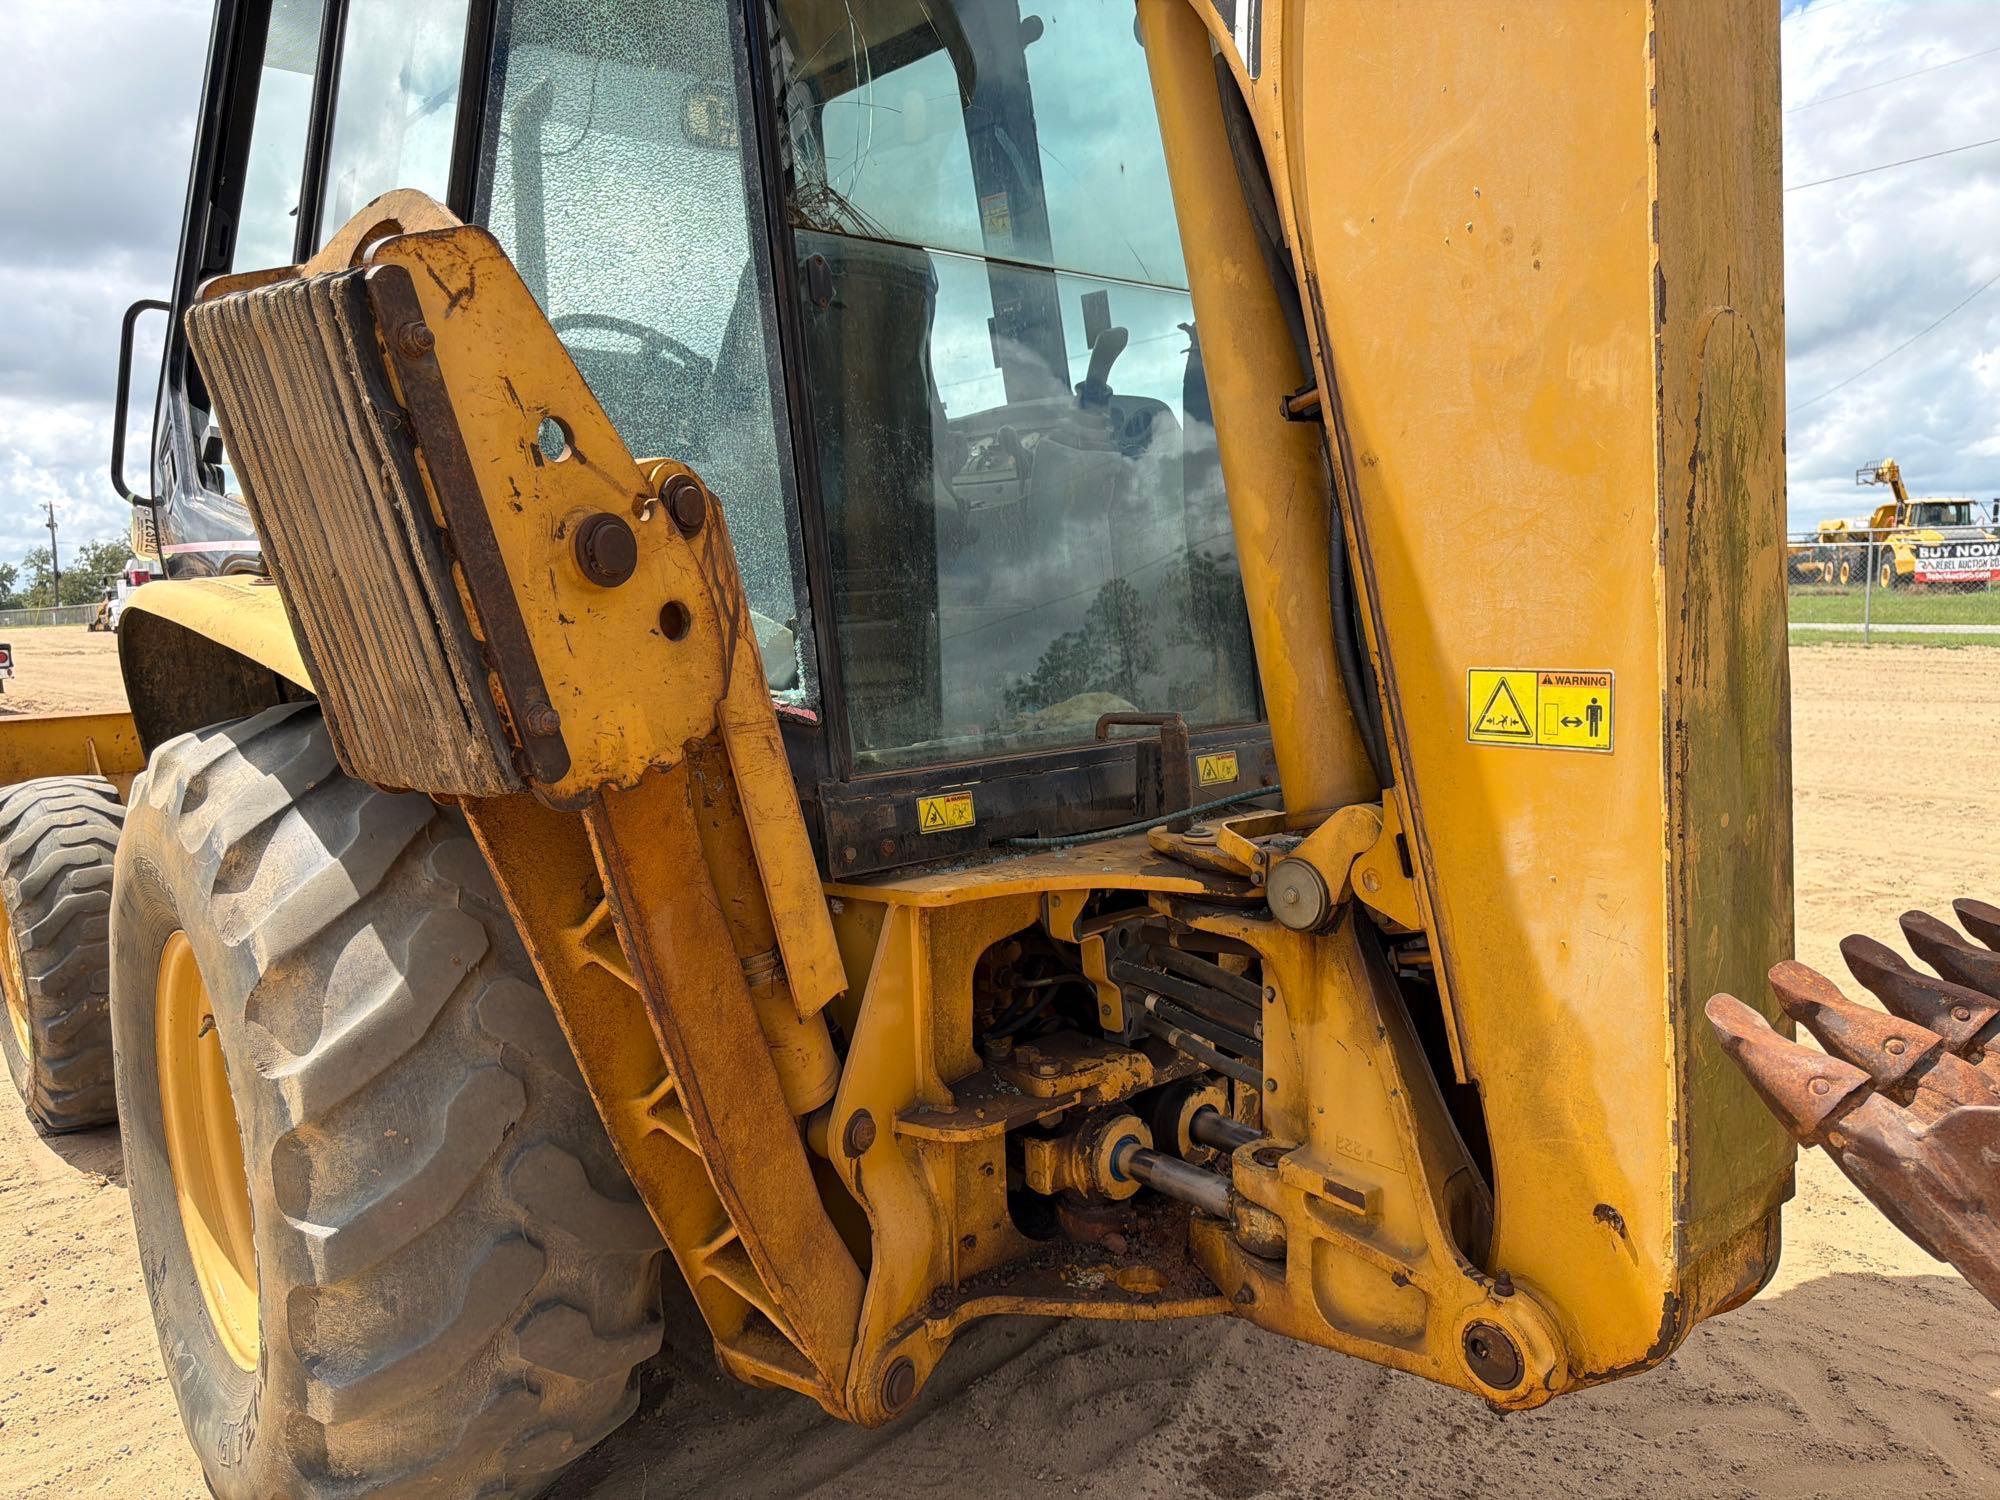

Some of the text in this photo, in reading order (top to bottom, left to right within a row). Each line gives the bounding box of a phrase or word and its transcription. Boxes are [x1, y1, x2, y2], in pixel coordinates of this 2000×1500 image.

[1919, 543, 2000, 558] BUY NOW
[1935, 560, 1955, 570] REBEL
[1958, 559, 1988, 570] AUCTION
[1555, 676, 1607, 687] WARNING
